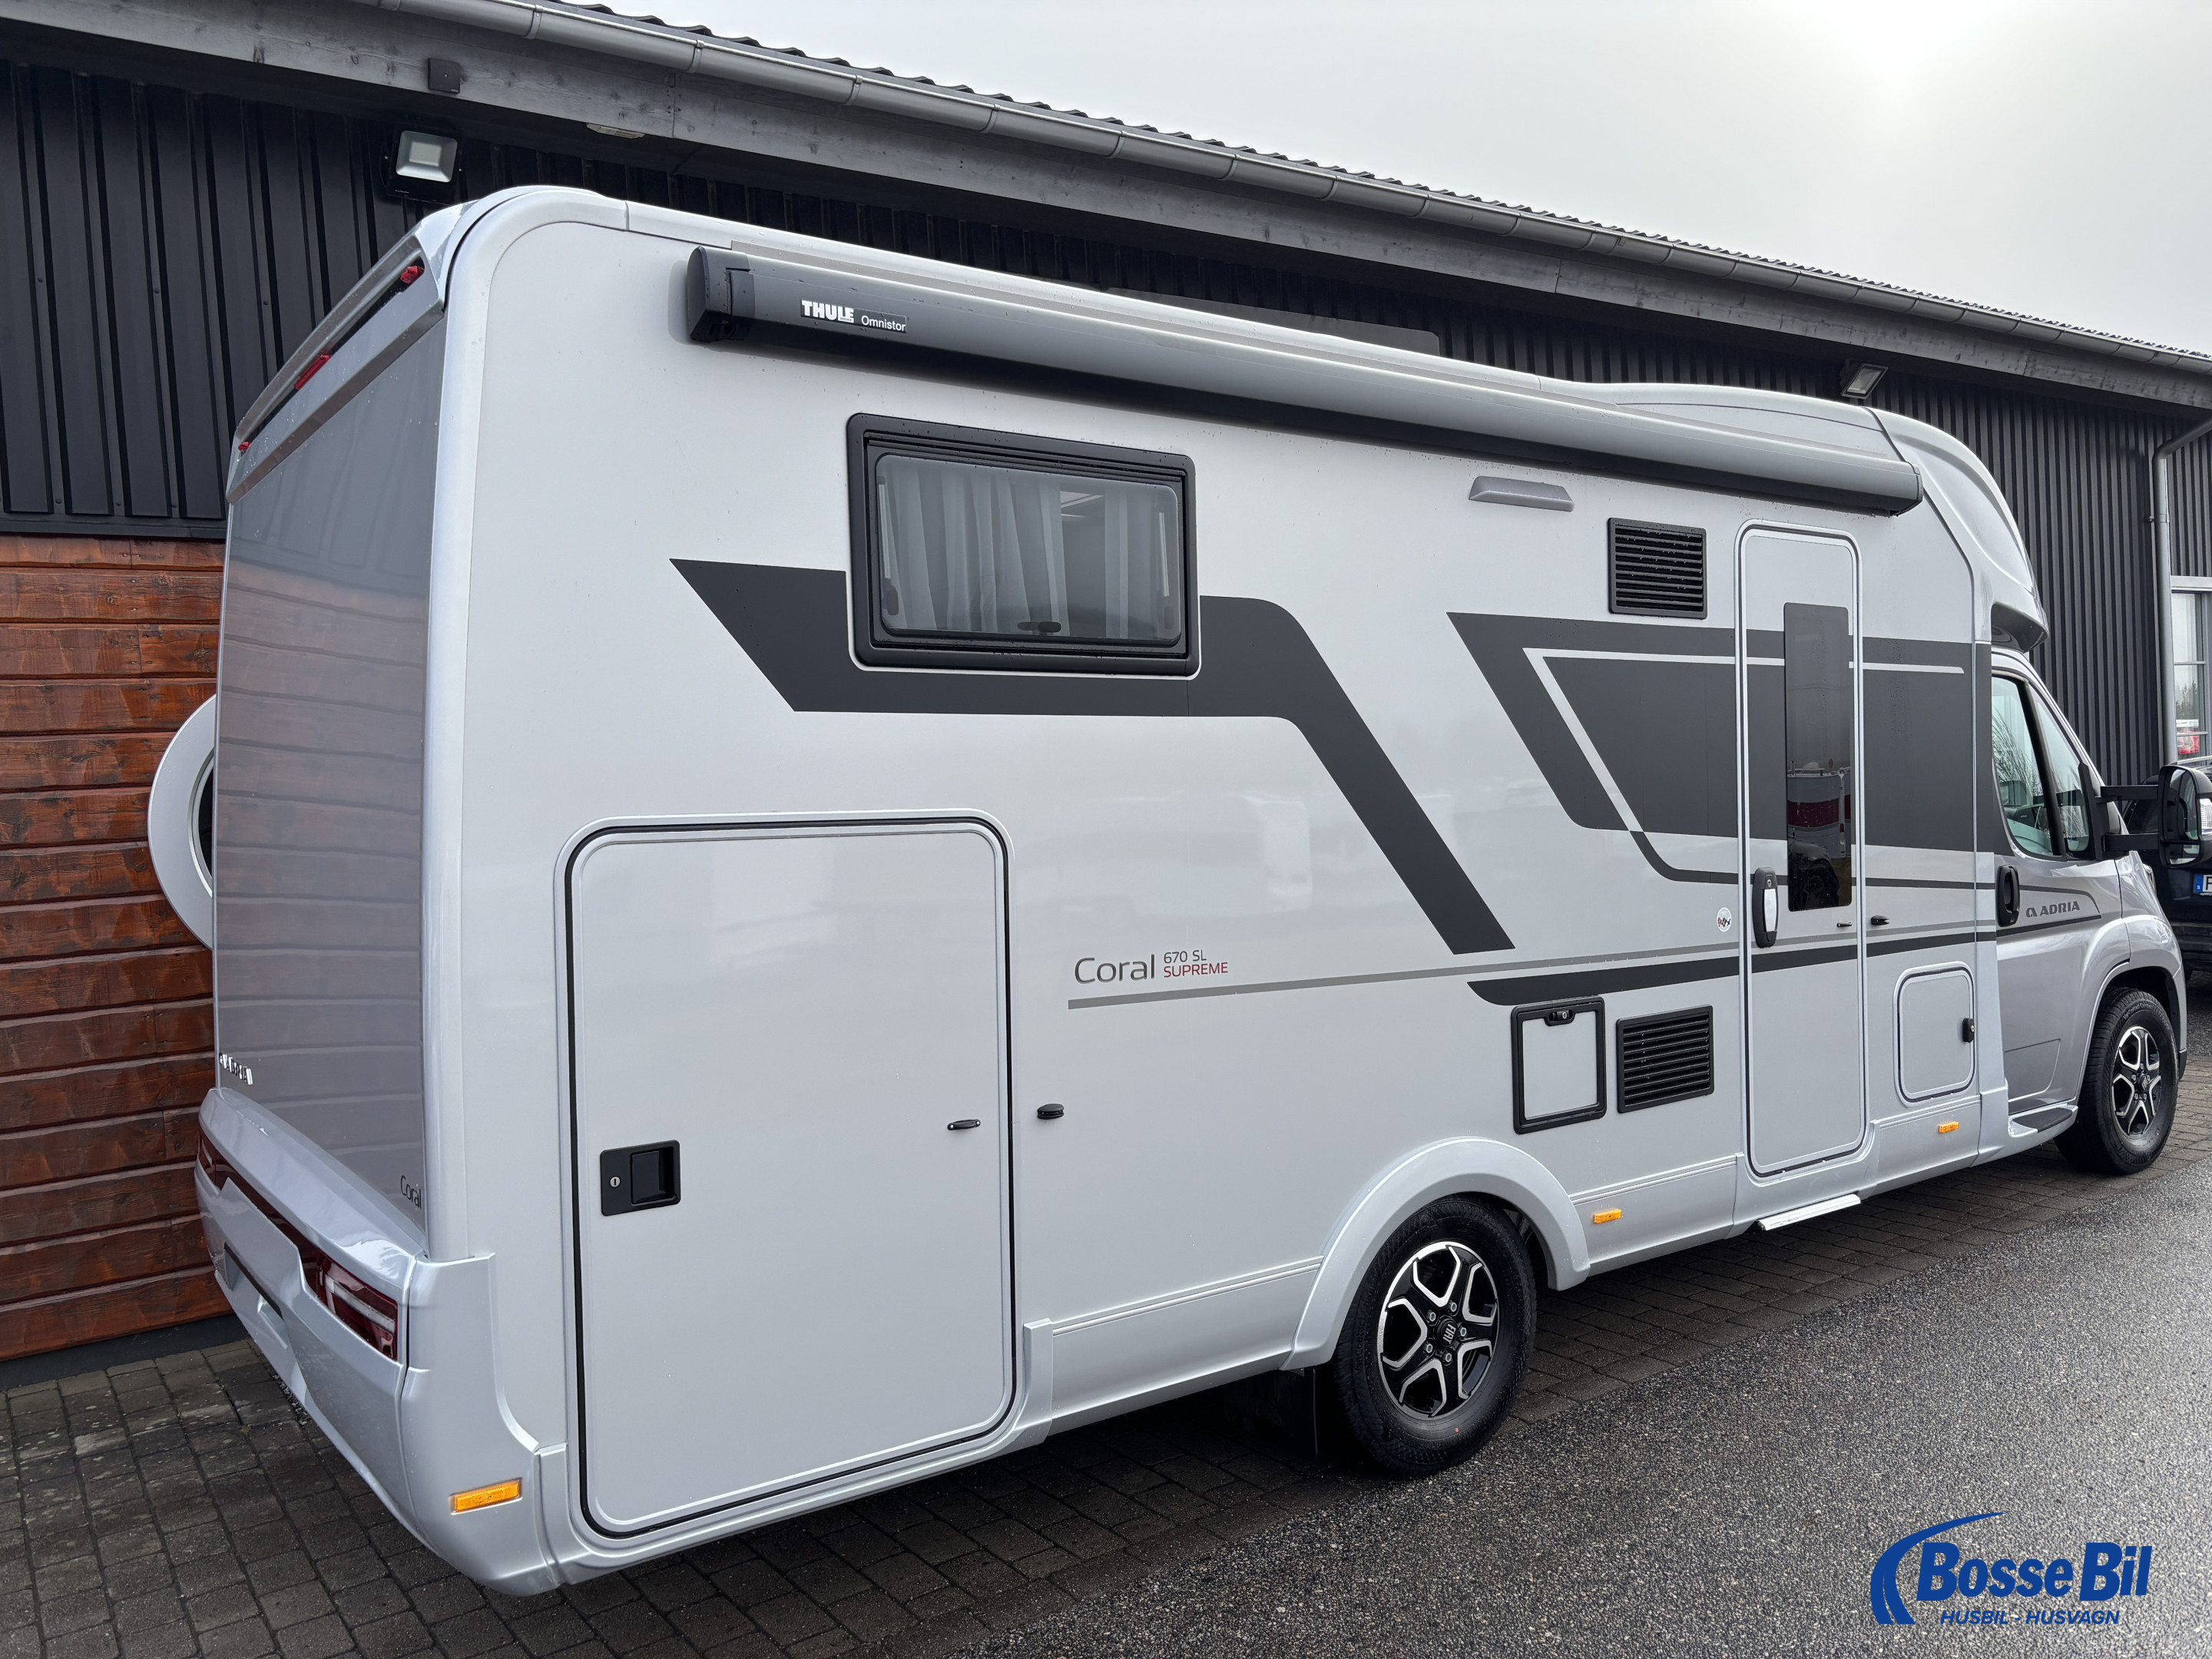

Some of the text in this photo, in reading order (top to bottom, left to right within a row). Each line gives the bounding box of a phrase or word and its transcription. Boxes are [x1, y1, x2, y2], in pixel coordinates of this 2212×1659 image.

[801, 300, 906, 332] THULE Omnistor
[2040, 901, 2081, 916] ADRIA
[1164, 949, 1207, 964] 670 SL
[1075, 953, 1155, 984] Coral
[1164, 962, 1229, 978] SUPREME
[400, 1174, 422, 1210] Coral
[1442, 1323, 1456, 1344] FIAT
